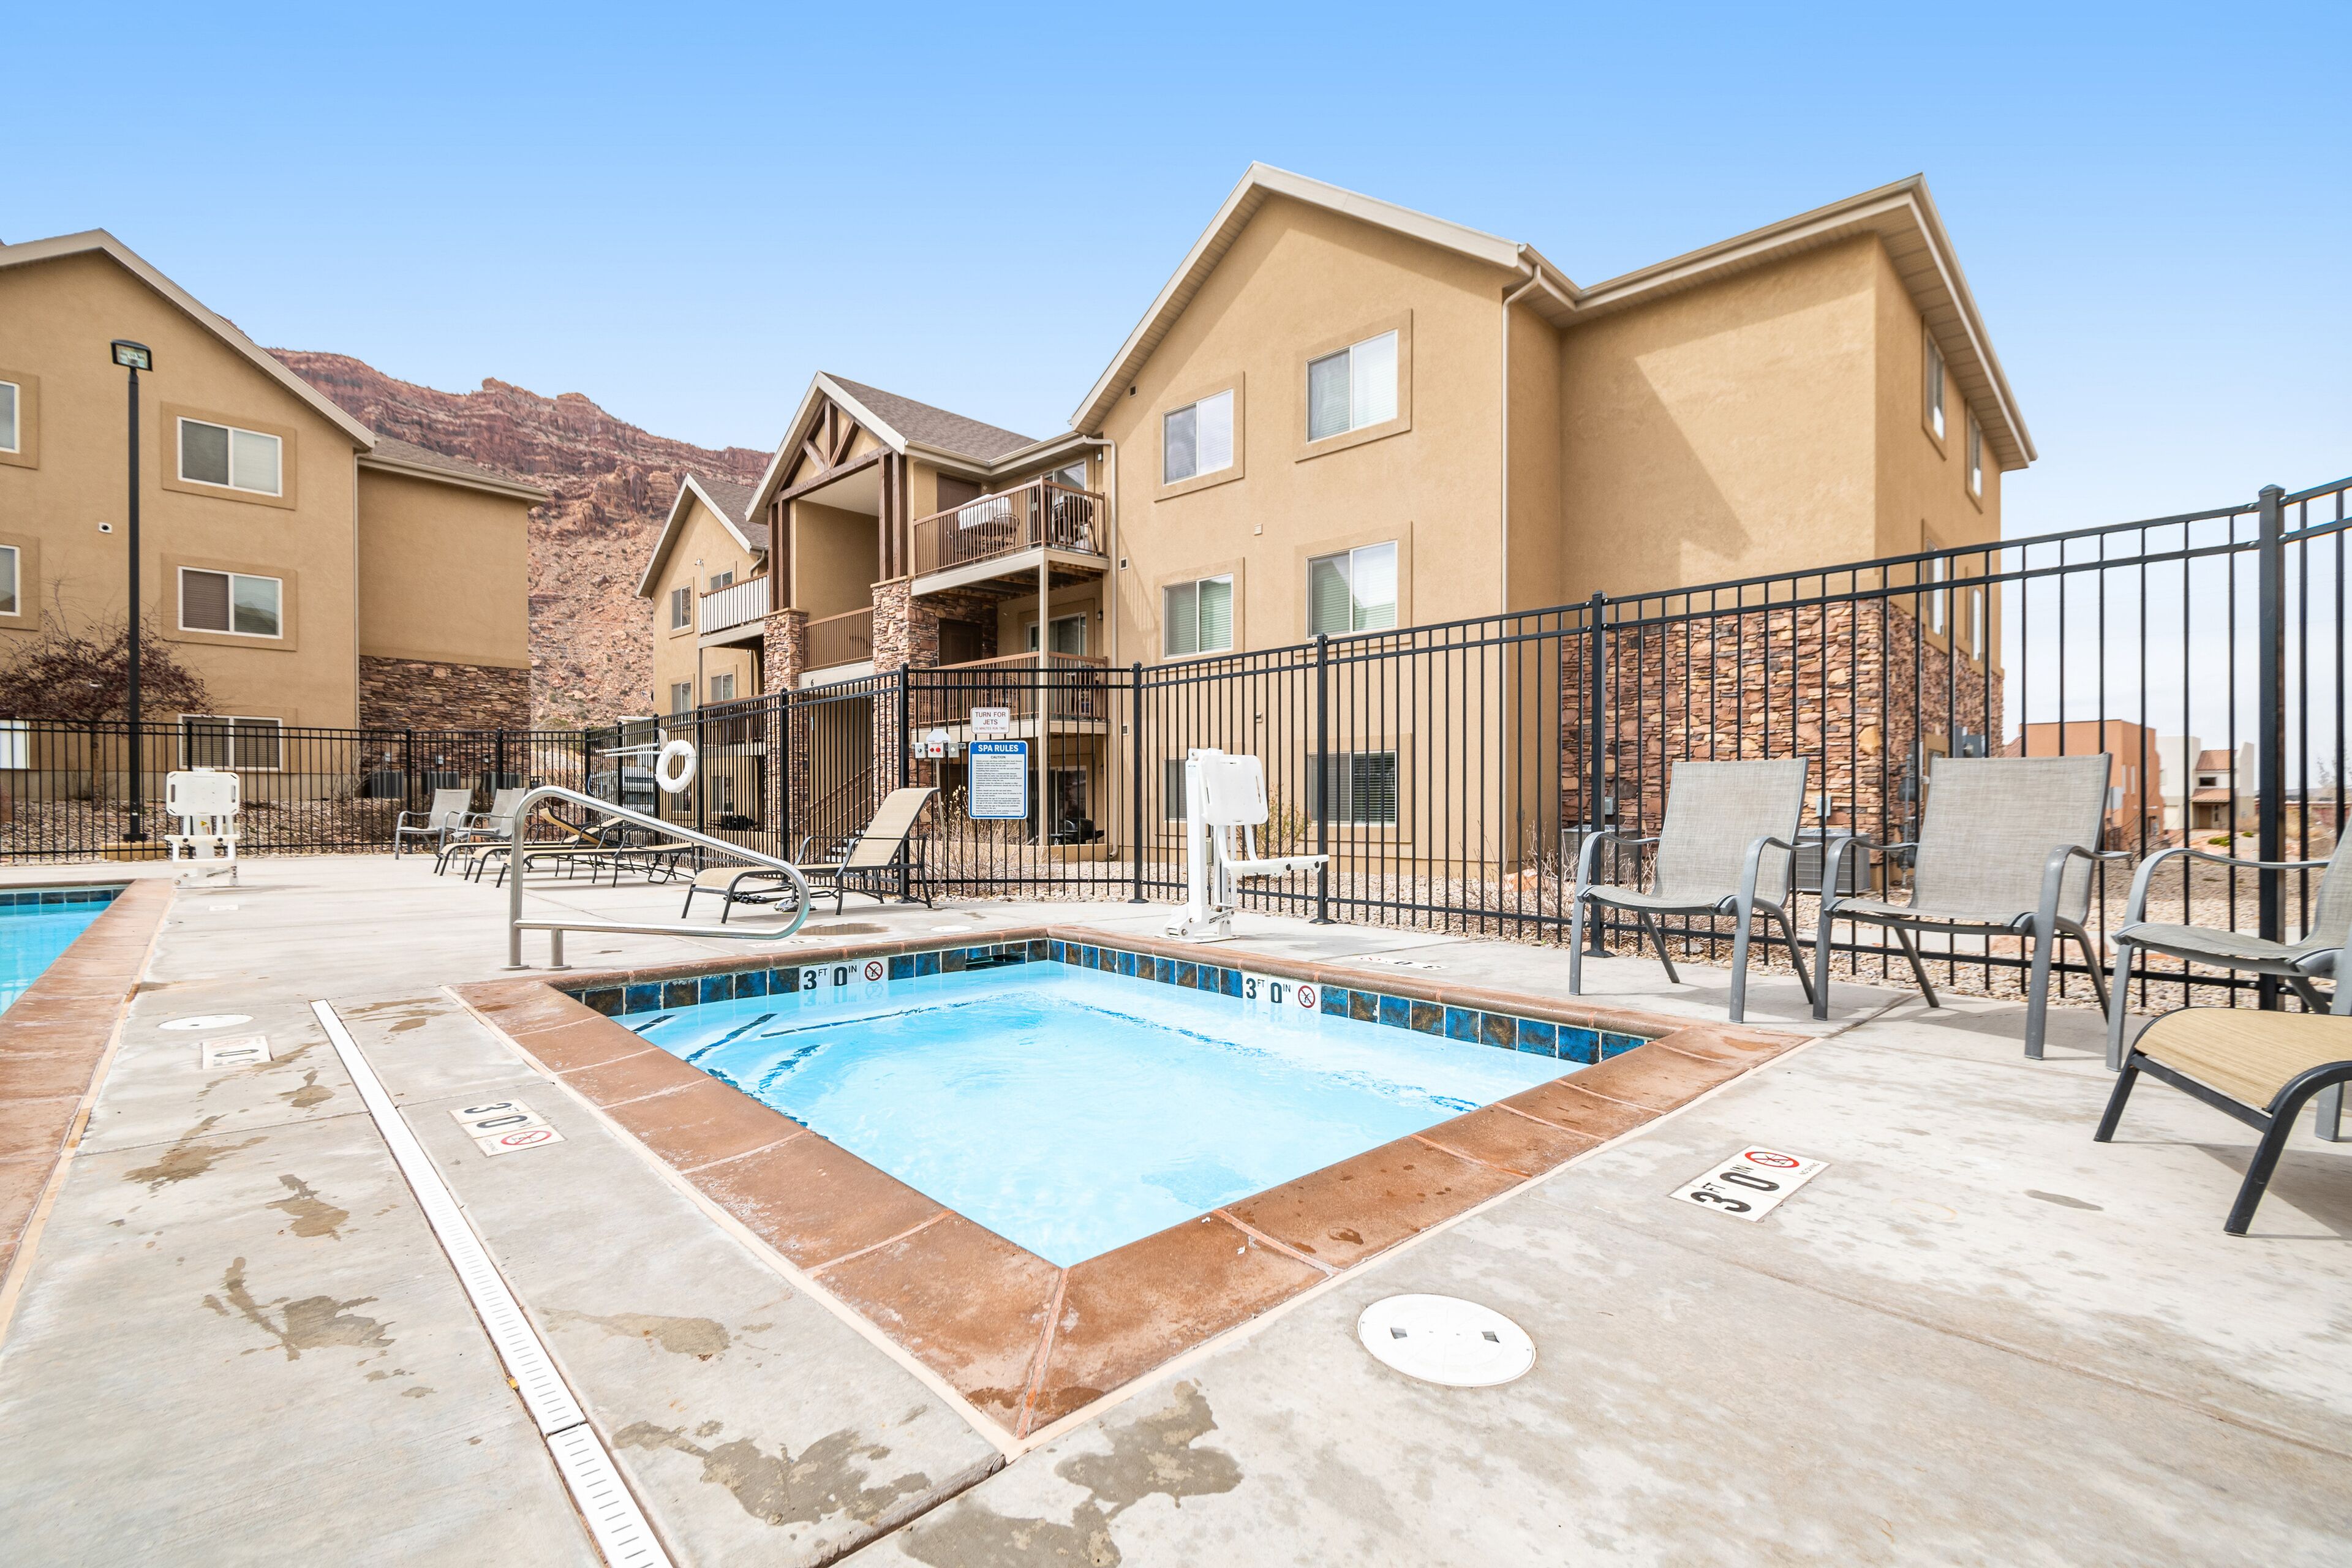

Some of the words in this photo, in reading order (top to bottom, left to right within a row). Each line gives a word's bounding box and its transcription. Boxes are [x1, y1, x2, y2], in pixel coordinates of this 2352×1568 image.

[804, 970, 817, 990] 3
[1246, 978, 1257, 1000] 3
[1691, 1191, 1751, 1213] 3
